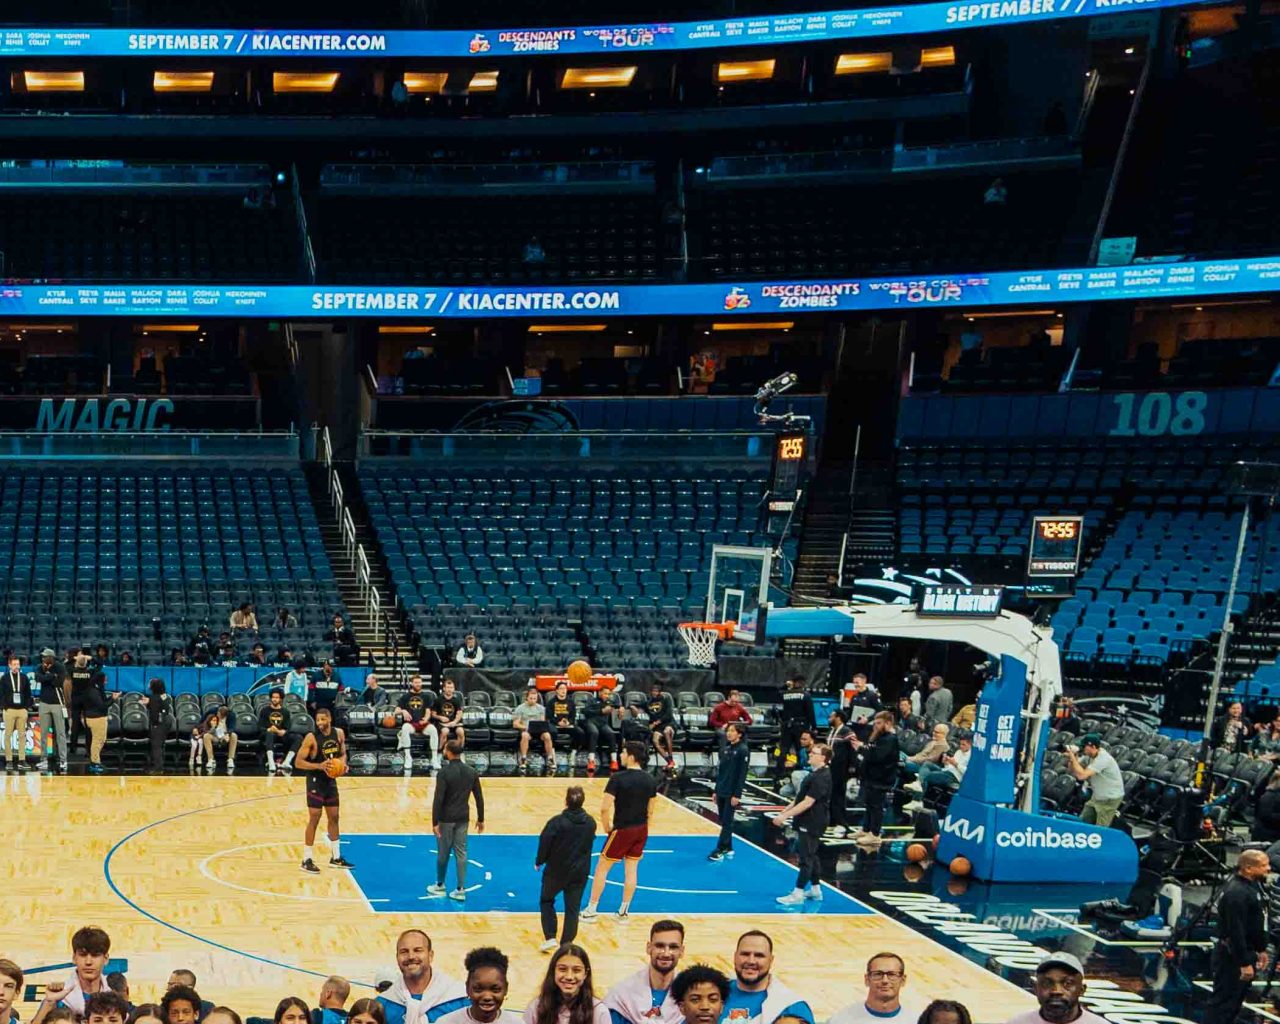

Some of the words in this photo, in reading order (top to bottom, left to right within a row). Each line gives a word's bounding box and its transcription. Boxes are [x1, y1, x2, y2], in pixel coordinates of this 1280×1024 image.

[946, 0, 1055, 23] SEPTEMBER
[128, 34, 219, 51] SEPTEMBER
[223, 34, 234, 51] 7
[252, 34, 387, 51] KIACENTER.COM
[498, 29, 576, 43] DESCENDANTS
[599, 32, 655, 47] TOUR
[512, 38, 560, 51] ZOMBIES
[762, 283, 860, 298] DESCENDANTS
[869, 281, 927, 291] WORLDS
[312, 293, 419, 310] SEPTEMBER
[423, 293, 438, 310] 7
[458, 291, 621, 310] KIACENTER.COM
[779, 294, 838, 308] ZOMBIES
[889, 286, 962, 304] TOUR
[35, 397, 175, 432] MAGIC
[1109, 391, 1208, 437] 108
[997, 715, 1015, 730] GET
[996, 826, 1103, 849] coinbase
